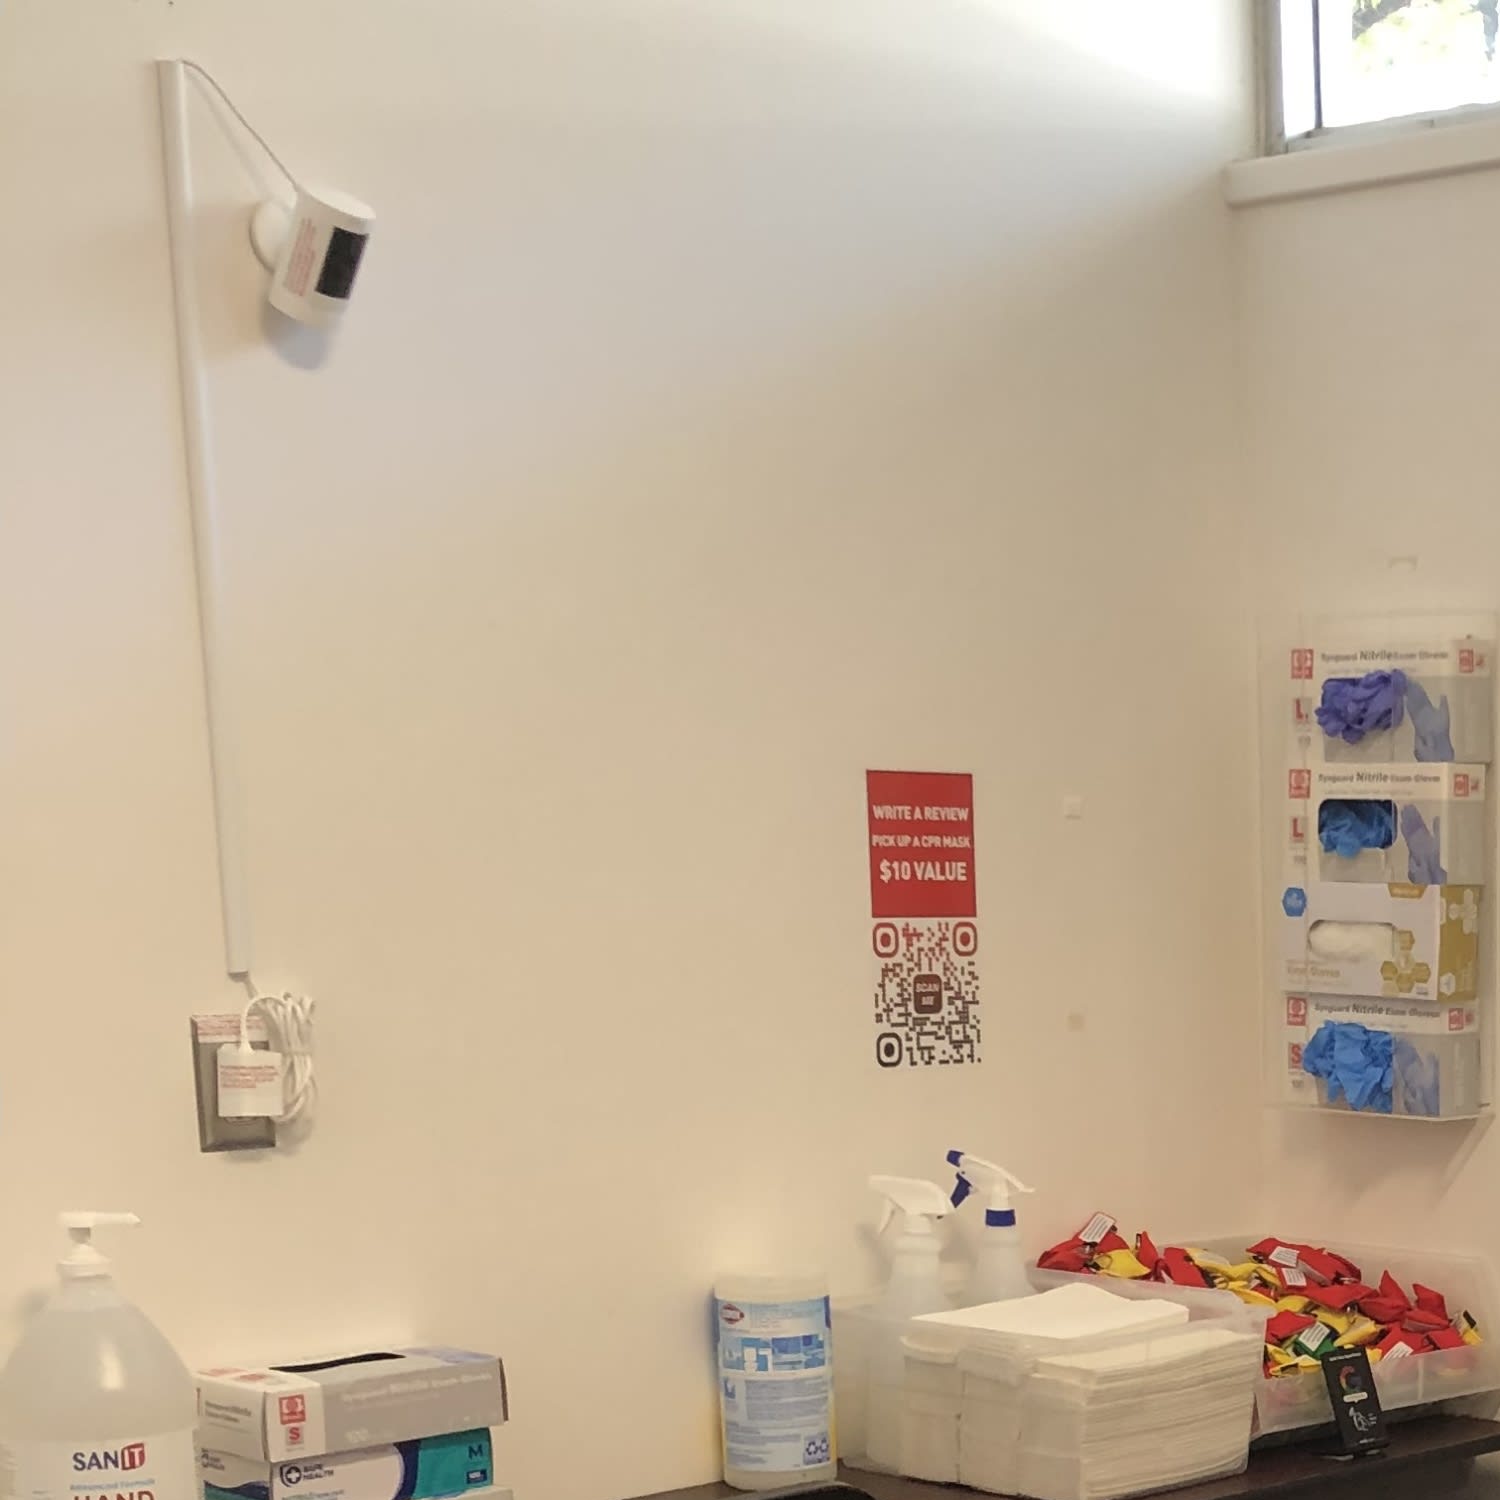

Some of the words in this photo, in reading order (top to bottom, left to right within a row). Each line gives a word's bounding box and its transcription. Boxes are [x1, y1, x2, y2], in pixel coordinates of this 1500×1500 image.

[1356, 772, 1389, 782] Nitrile
[873, 805, 912, 820] WRITE
[914, 806, 922, 820] A
[924, 806, 969, 821] REVIEW
[1293, 818, 1304, 838] L
[872, 835, 896, 847] PICK
[897, 835, 911, 847] UP
[912, 836, 921, 847] A
[922, 835, 941, 847] CPR
[943, 836, 970, 848] MASK
[880, 859, 911, 883] $10
[914, 861, 967, 881] VALUE
[1352, 1003, 1385, 1015] Nitrile
[289, 1427, 300, 1441] S
[468, 1444, 483, 1459] M
